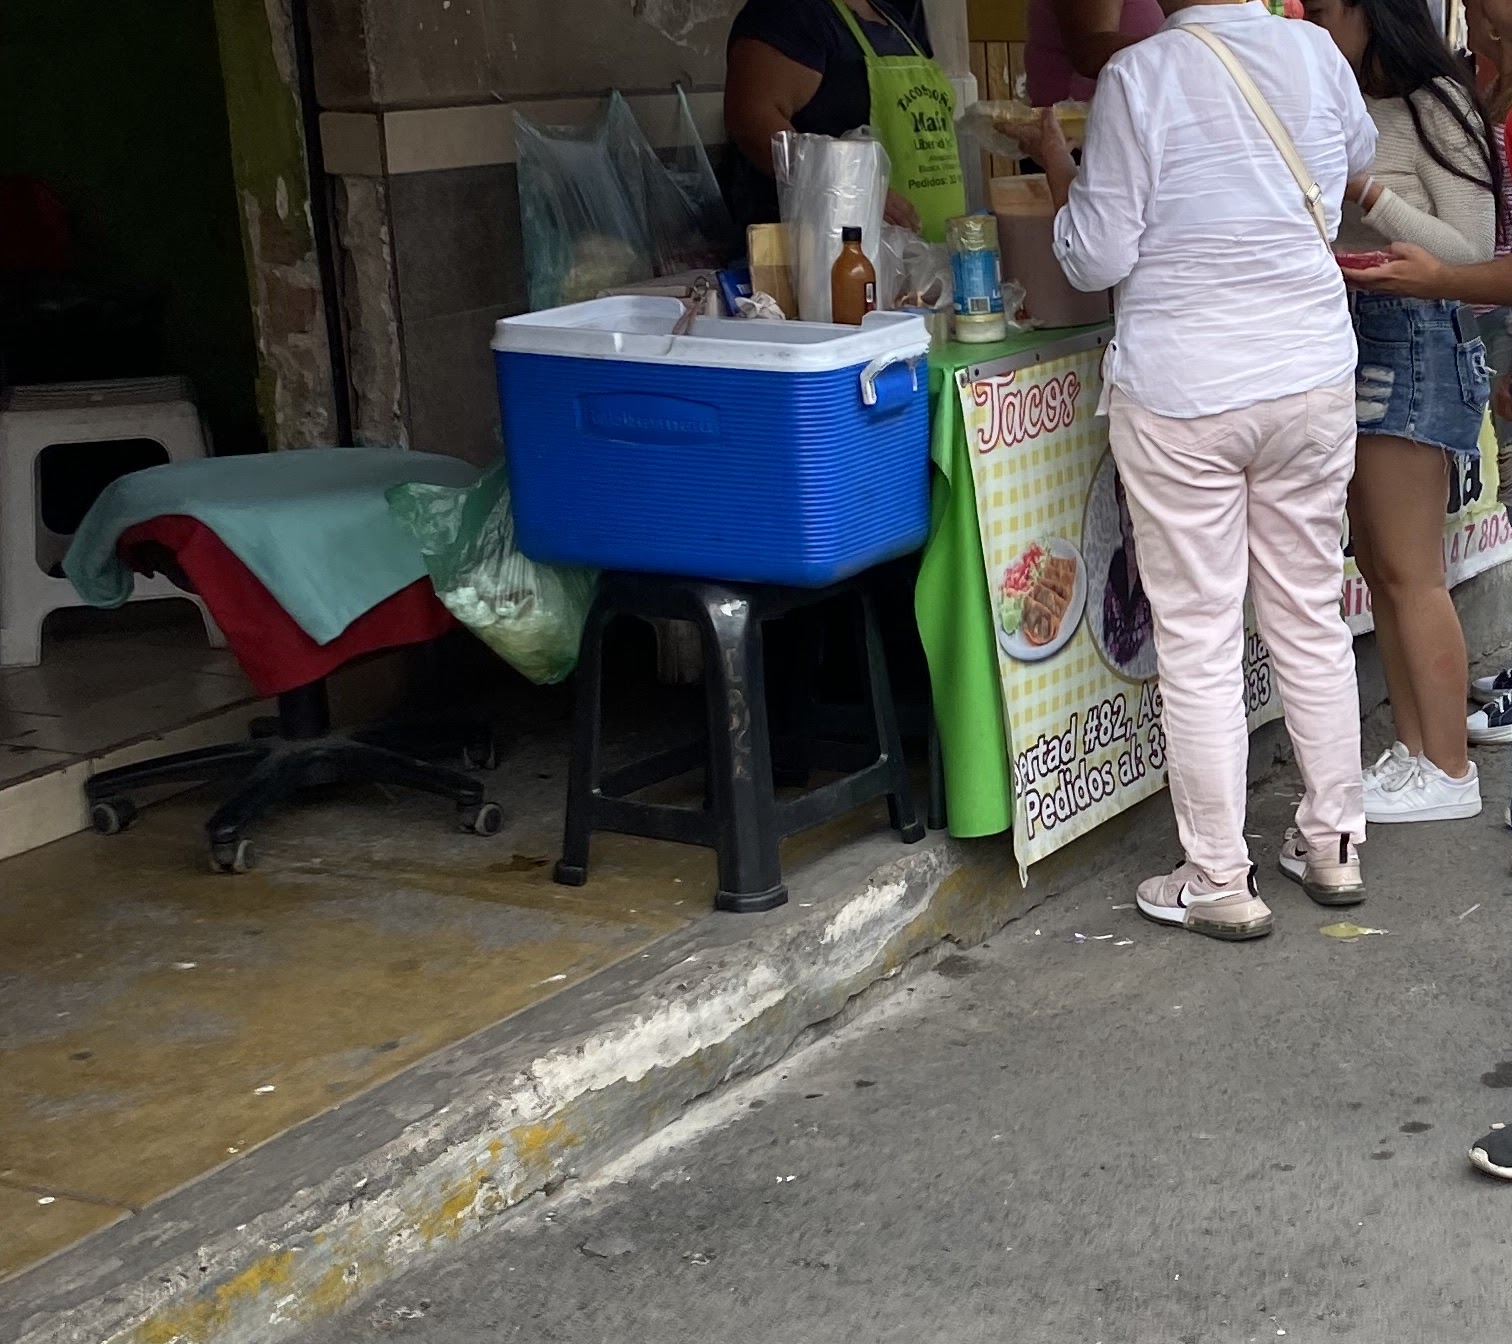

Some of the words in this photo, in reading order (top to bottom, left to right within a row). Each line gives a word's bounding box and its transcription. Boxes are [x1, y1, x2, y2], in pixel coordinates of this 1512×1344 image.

[972, 370, 1082, 454] Tacos
[1025, 759, 1115, 841] Pedidos
[1119, 733, 1146, 788] al:
